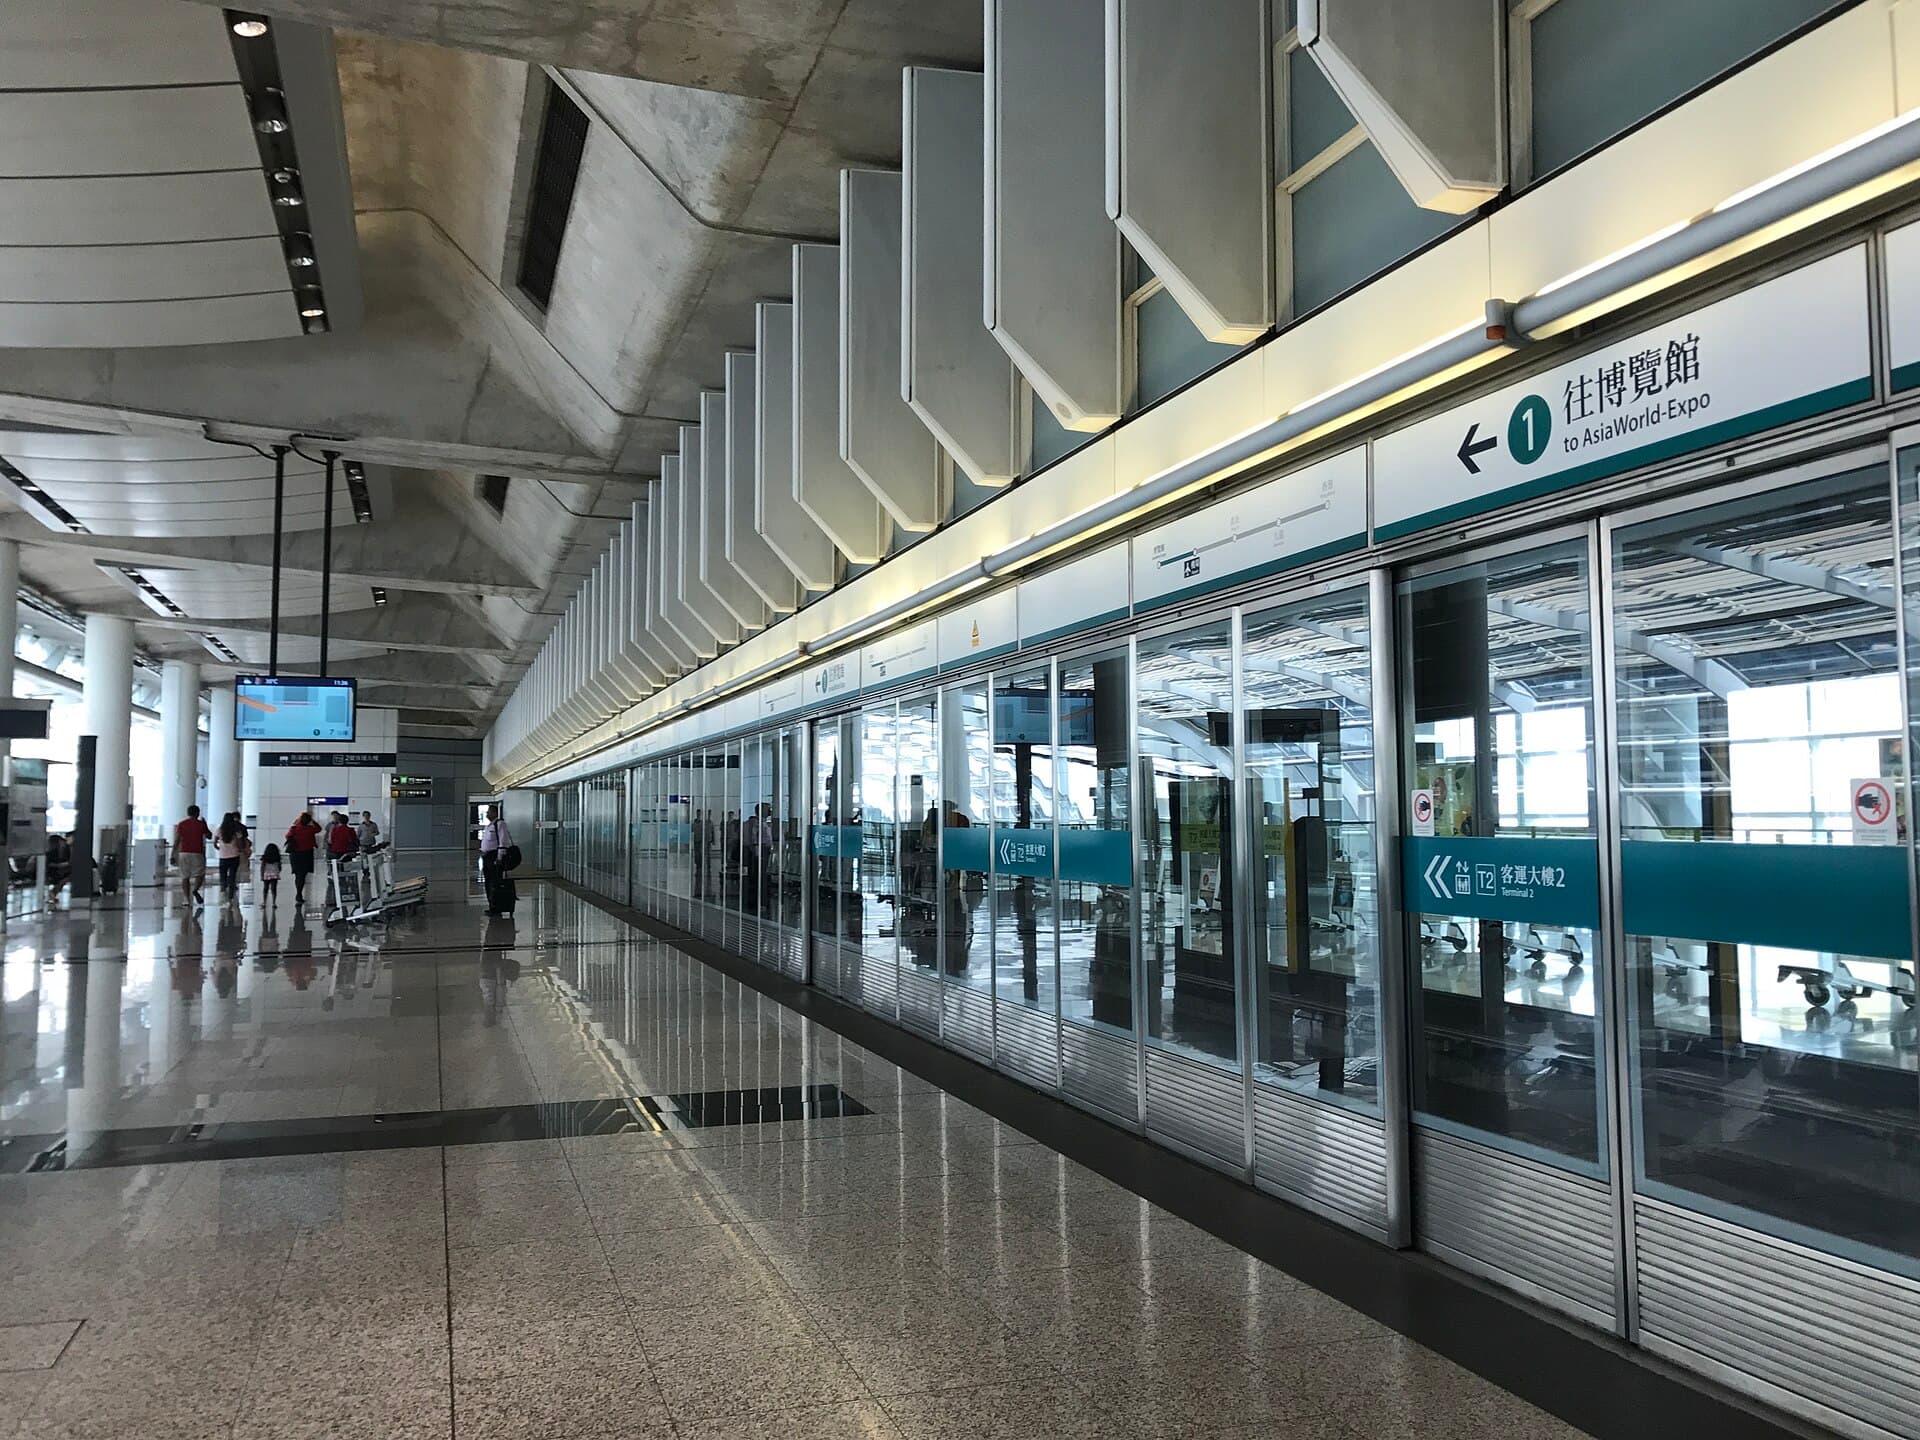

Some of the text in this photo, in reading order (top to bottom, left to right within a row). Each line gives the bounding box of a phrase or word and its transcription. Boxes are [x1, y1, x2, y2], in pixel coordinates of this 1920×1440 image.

[1564, 333, 1700, 425] 往博覽館
[1521, 407, 1534, 451] 1
[1564, 393, 1711, 453] to AsiaWorld-Expo
[1478, 870, 1495, 889] T2
[1500, 864, 1566, 888] 客運大樓2
[1501, 887, 1534, 898] Terminal 2
